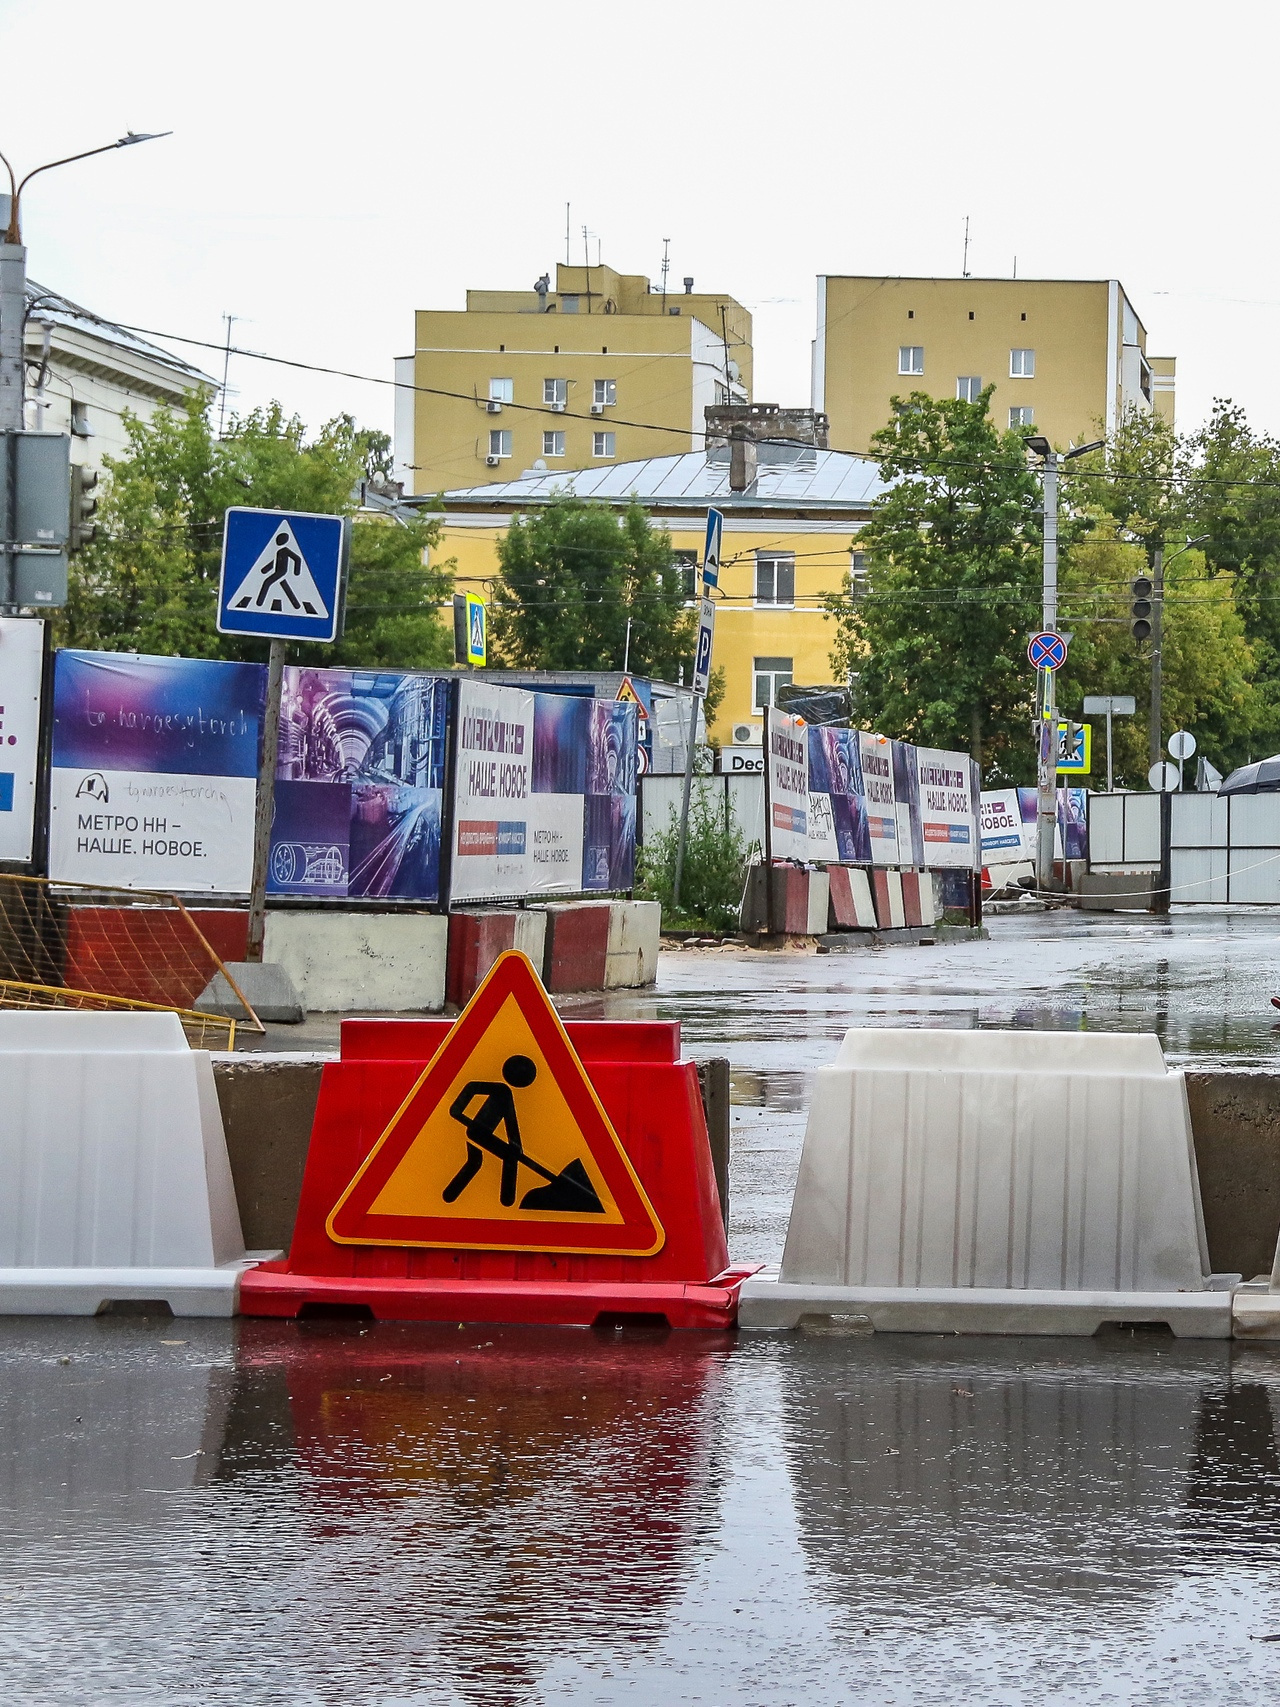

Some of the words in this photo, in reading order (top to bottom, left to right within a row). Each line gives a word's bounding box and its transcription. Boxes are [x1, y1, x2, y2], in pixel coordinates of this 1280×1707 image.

[78, 814, 138, 832] МЕТРО
[143, 817, 167, 833] НН
[77, 837, 137, 855] НАШЕ.
[142, 839, 207, 857] НОВОЕ.
